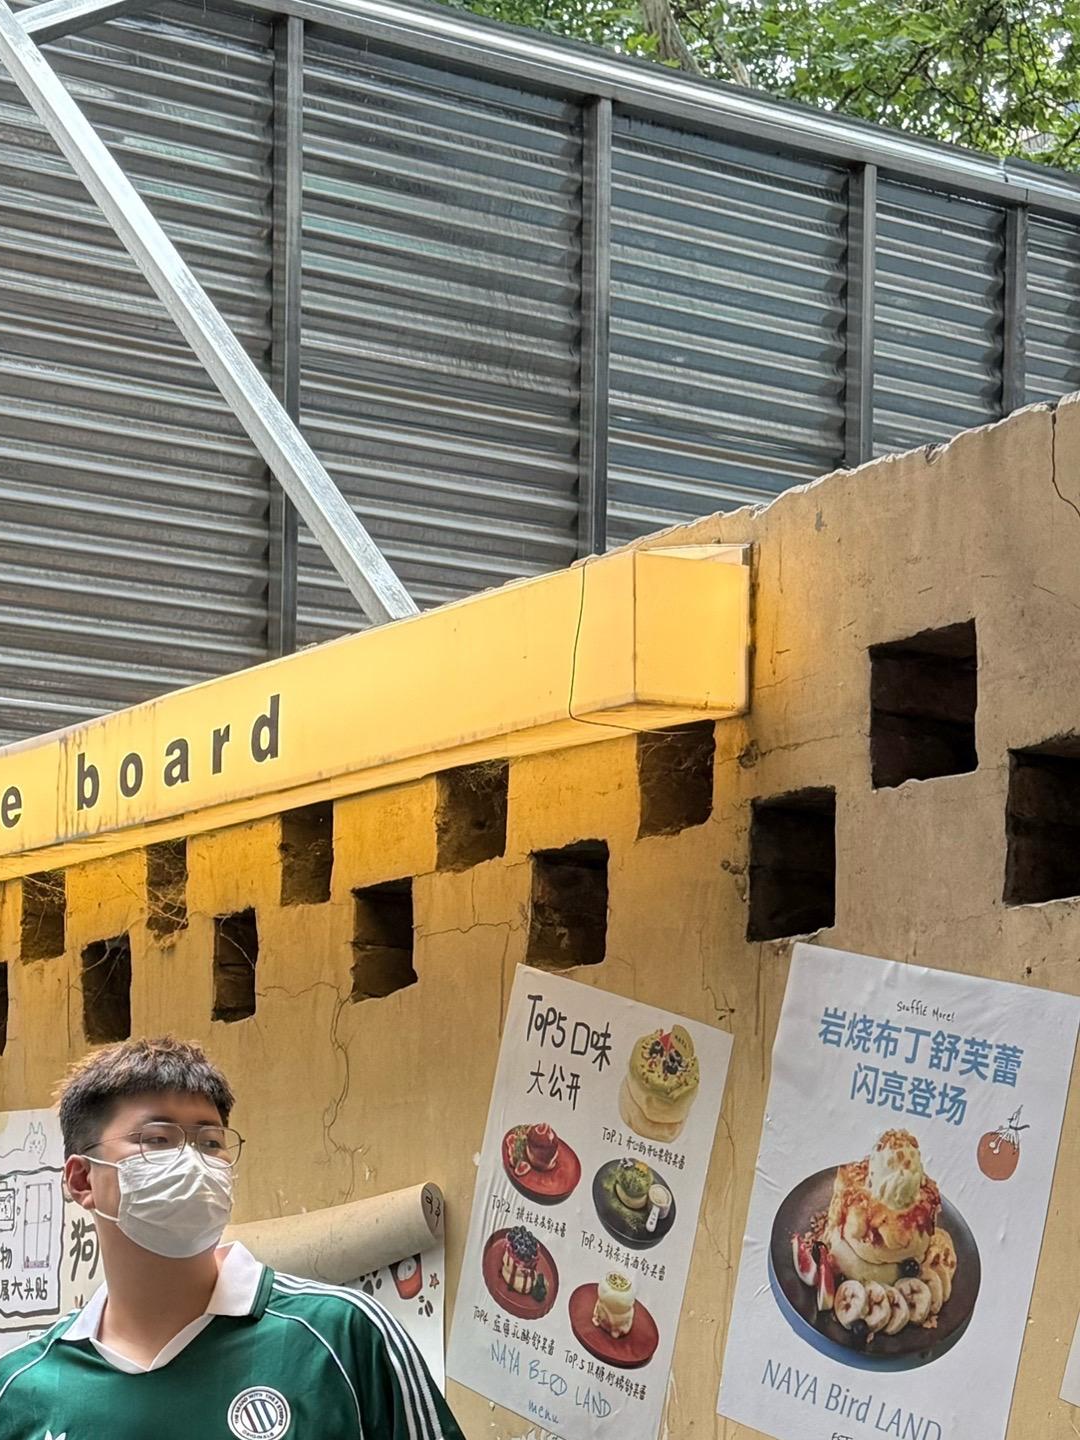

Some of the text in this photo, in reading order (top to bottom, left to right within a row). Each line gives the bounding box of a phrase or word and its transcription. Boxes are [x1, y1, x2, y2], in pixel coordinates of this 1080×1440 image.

[77, 693, 281, 812] board
[932, 1008, 956, 1022] More!
[819, 1007, 1024, 1088] 岩烧布丁舒芙蕾
[526, 1060, 581, 1111] 大公开
[850, 1062, 967, 1126] 闪亮登场
[491, 1339, 520, 1376] NAYA
[575, 1386, 612, 1418] LAND
[761, 1359, 818, 1405] NAYA
[825, 1383, 872, 1424] Bird
[529, 1400, 560, 1424] menu
